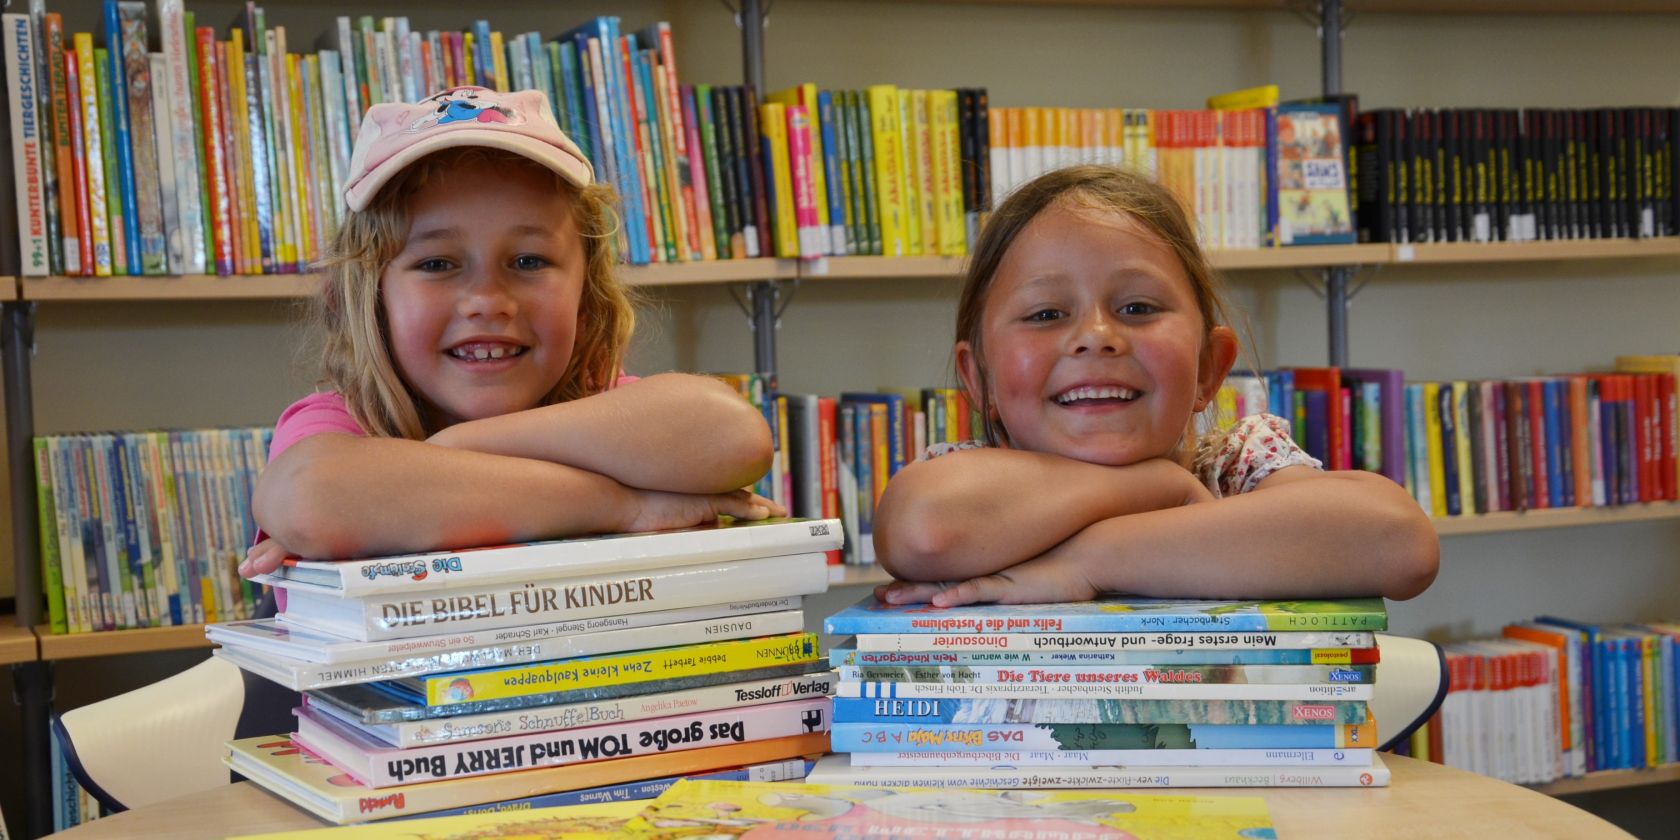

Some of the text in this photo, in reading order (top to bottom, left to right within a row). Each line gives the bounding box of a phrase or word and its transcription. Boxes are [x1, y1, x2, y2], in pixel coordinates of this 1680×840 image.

[16, 18, 43, 267] 99+1 KUNTERBUNTE TIERGESCHICHTEN
[432, 557, 463, 572] Die
[382, 578, 655, 628] DIE BIBEL FÜR KINDER
[911, 618, 1062, 632] Felix und die Pusteblume
[1141, 616, 1165, 625] Nork
[1289, 616, 1367, 625] PATTLOCH
[495, 618, 629, 641] Hansgeorg Stengel Karl Schrader
[705, 621, 752, 635] DAUSIEN
[387, 635, 475, 654] So ein Struwwelpeter
[932, 636, 1008, 648] Dinosaurier
[1034, 634, 1276, 648] Mein erstes Frage- und Antwortbuch
[517, 645, 541, 657] DER
[1051, 653, 1115, 661] Katharina Wieker
[663, 654, 727, 670] Debbie Tarbett
[861, 652, 930, 664] Kindergarten
[933, 653, 958, 662] Mein
[1004, 654, 1020, 662] wie
[1021, 654, 1031, 662] W
[318, 665, 366, 681] HIMMEL
[503, 660, 652, 687] Zehn kleine Kaulquappen
[852, 671, 865, 679] Ria
[915, 671, 940, 680] Esther
[958, 671, 981, 680] Hacht
[997, 669, 1201, 683] Die Tiere unseres Waldes
[1330, 670, 1360, 681] XENOS
[734, 680, 830, 702] Tessloff Verlag
[914, 684, 944, 694] Finsch
[946, 684, 967, 694] Tobi
[986, 684, 1049, 695] Tierarztpraxis
[1057, 685, 1112, 694] Steinbacher
[1115, 685, 1144, 695] Judith
[640, 701, 672, 714] Angelika
[874, 701, 941, 717] HEIDI
[1294, 706, 1334, 718] XENOS
[908, 728, 945, 747] Maja
[987, 731, 1024, 743] DAS
[388, 720, 745, 781] Das große TOM und JERRY Buch
[1029, 752, 1089, 760] Maar Maar
[1265, 751, 1314, 761] Ellermann
[896, 752, 1020, 762] Die Biberburgenbaumeister
[912, 778, 945, 788] kleinen
[969, 776, 1019, 787] Geschichte
[1155, 776, 1170, 786] Die
[1279, 775, 1323, 786] Willberg
[580, 791, 612, 803] Warnes
[612, 787, 631, 800] Tim
